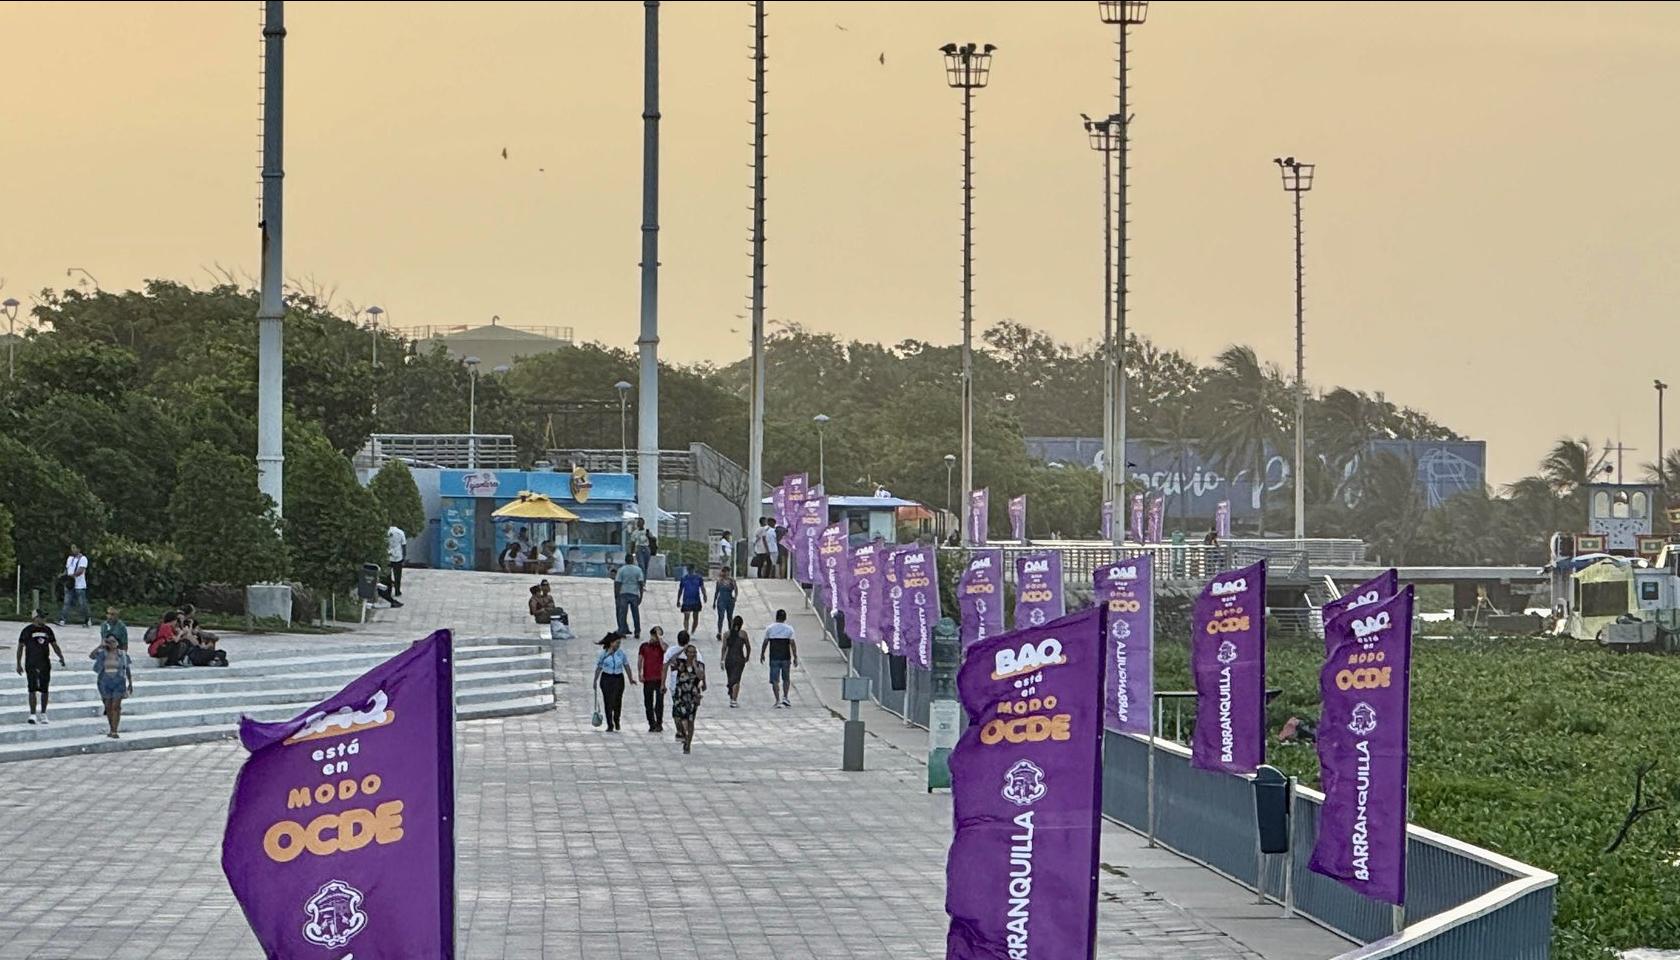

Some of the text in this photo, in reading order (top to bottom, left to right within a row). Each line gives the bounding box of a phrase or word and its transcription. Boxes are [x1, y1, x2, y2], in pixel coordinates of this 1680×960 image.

[1212, 578, 1248, 594] BAQ
[1206, 616, 1250, 634] OCDE
[1351, 611, 1390, 637] BAQ
[995, 638, 1063, 676] BAQ
[1348, 652, 1384, 665] MODO
[1014, 671, 1043, 688] está
[1336, 667, 1392, 690] OCDE
[1021, 687, 1035, 697] en
[997, 696, 1057, 714] MODO
[1220, 667, 1232, 762] BARRANQUILLA
[980, 714, 1071, 745] OCDE
[312, 738, 360, 762] está
[322, 760, 349, 776] en
[287, 774, 382, 809] MODO
[1352, 740, 1371, 880] BARRANQUILLA
[263, 800, 404, 863] OCDE
